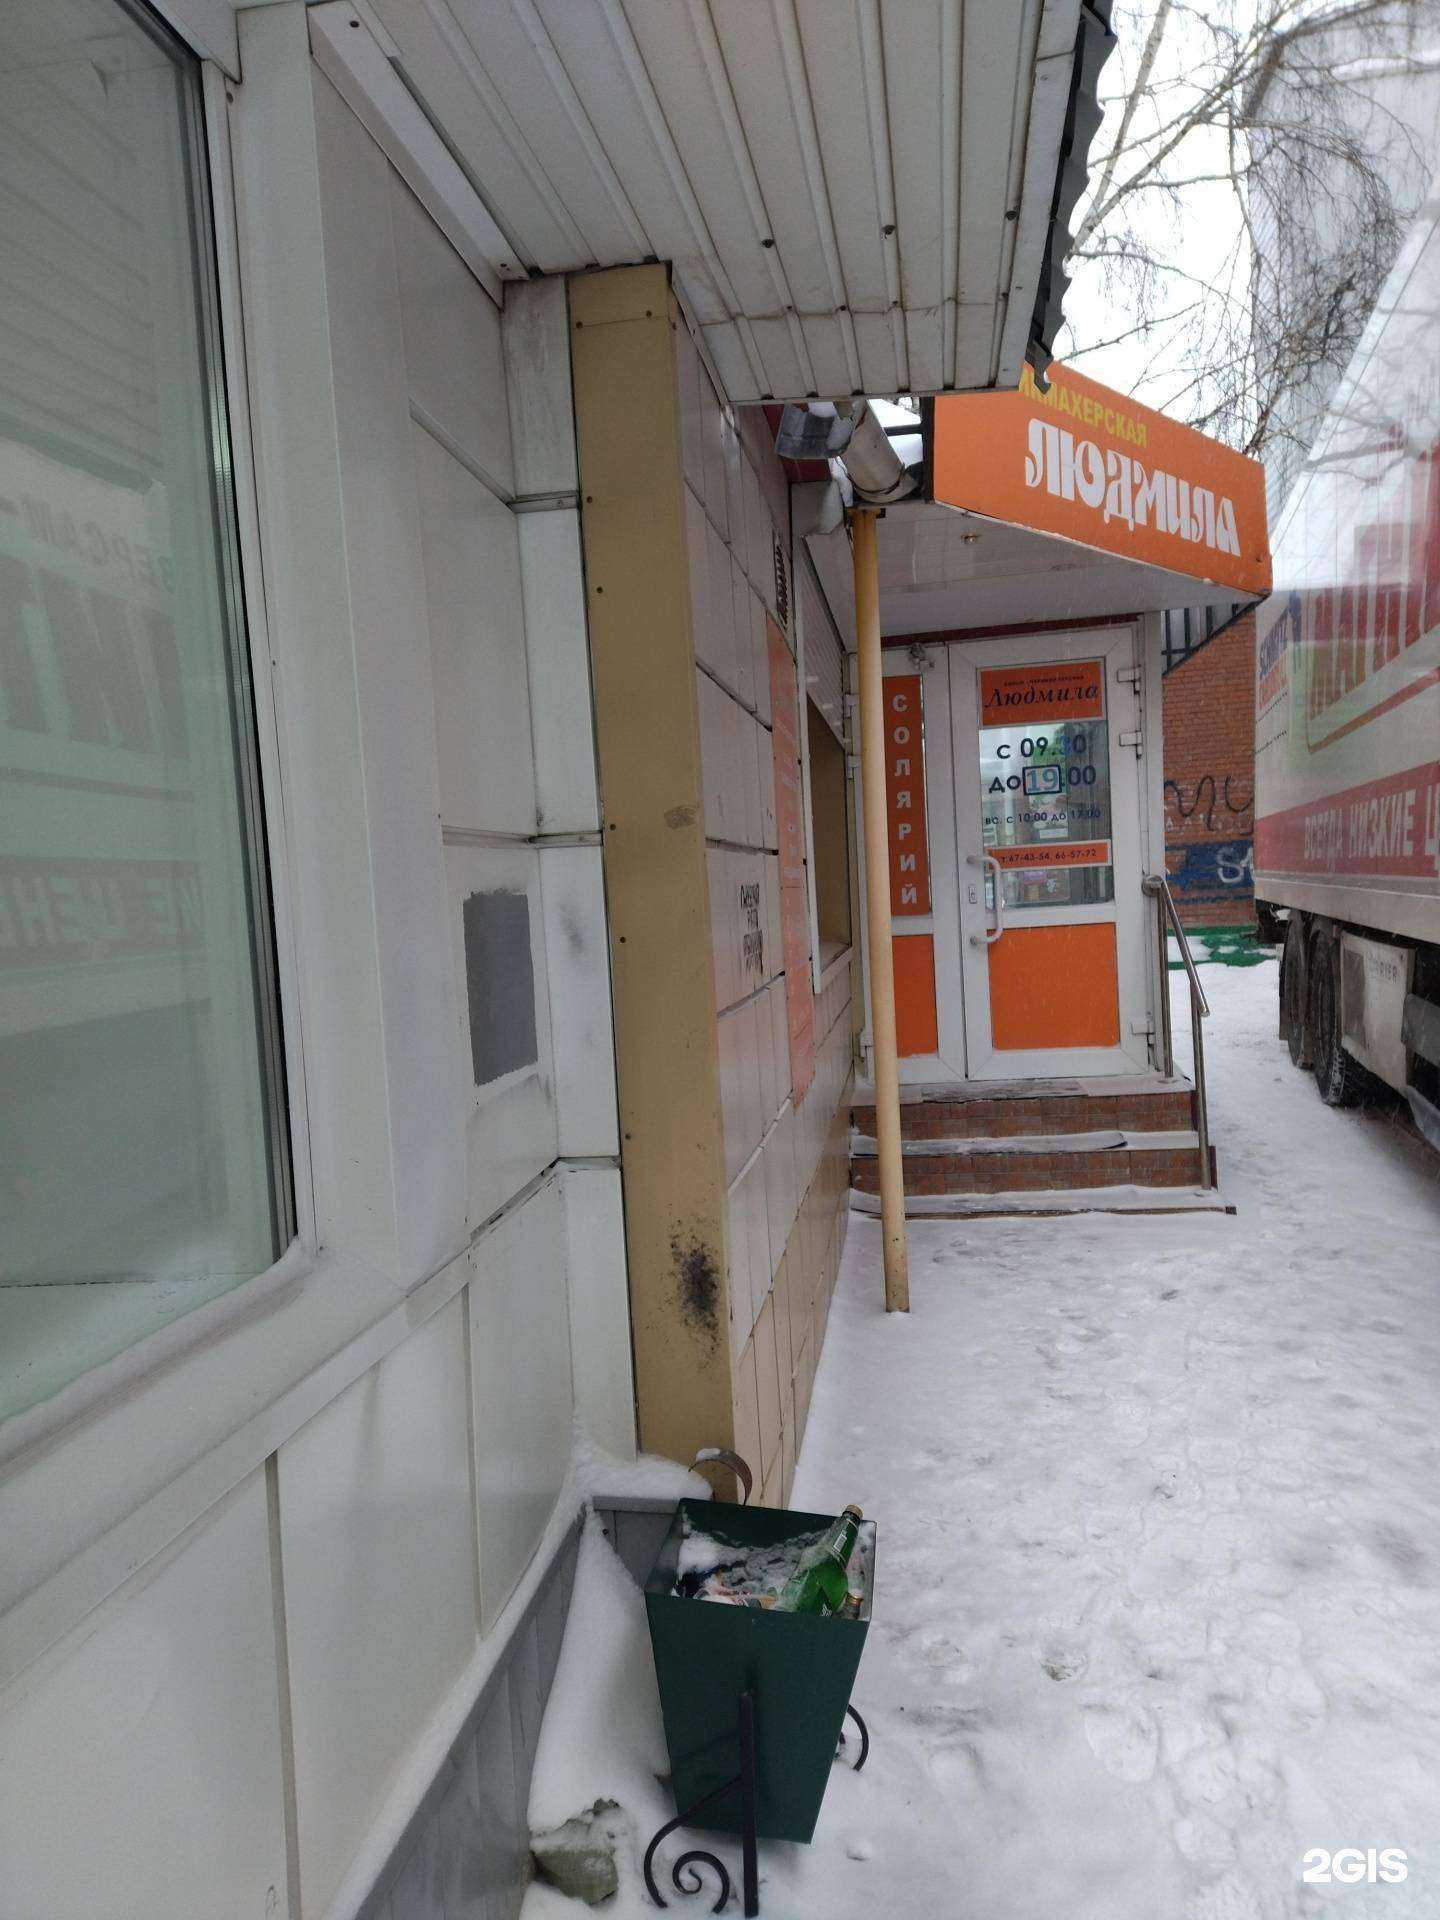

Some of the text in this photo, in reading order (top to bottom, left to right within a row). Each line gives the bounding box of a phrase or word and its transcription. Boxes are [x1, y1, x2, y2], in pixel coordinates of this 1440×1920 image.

[1025, 418, 1241, 557] ЛЮДМИЛА
[985, 685, 1099, 709] Людмила
[1020, 734, 1086, 758] 09.30
[893, 694, 918, 904] СОЛЯРИЙ
[1349, 788, 1417, 858] НИЗКИЕ
